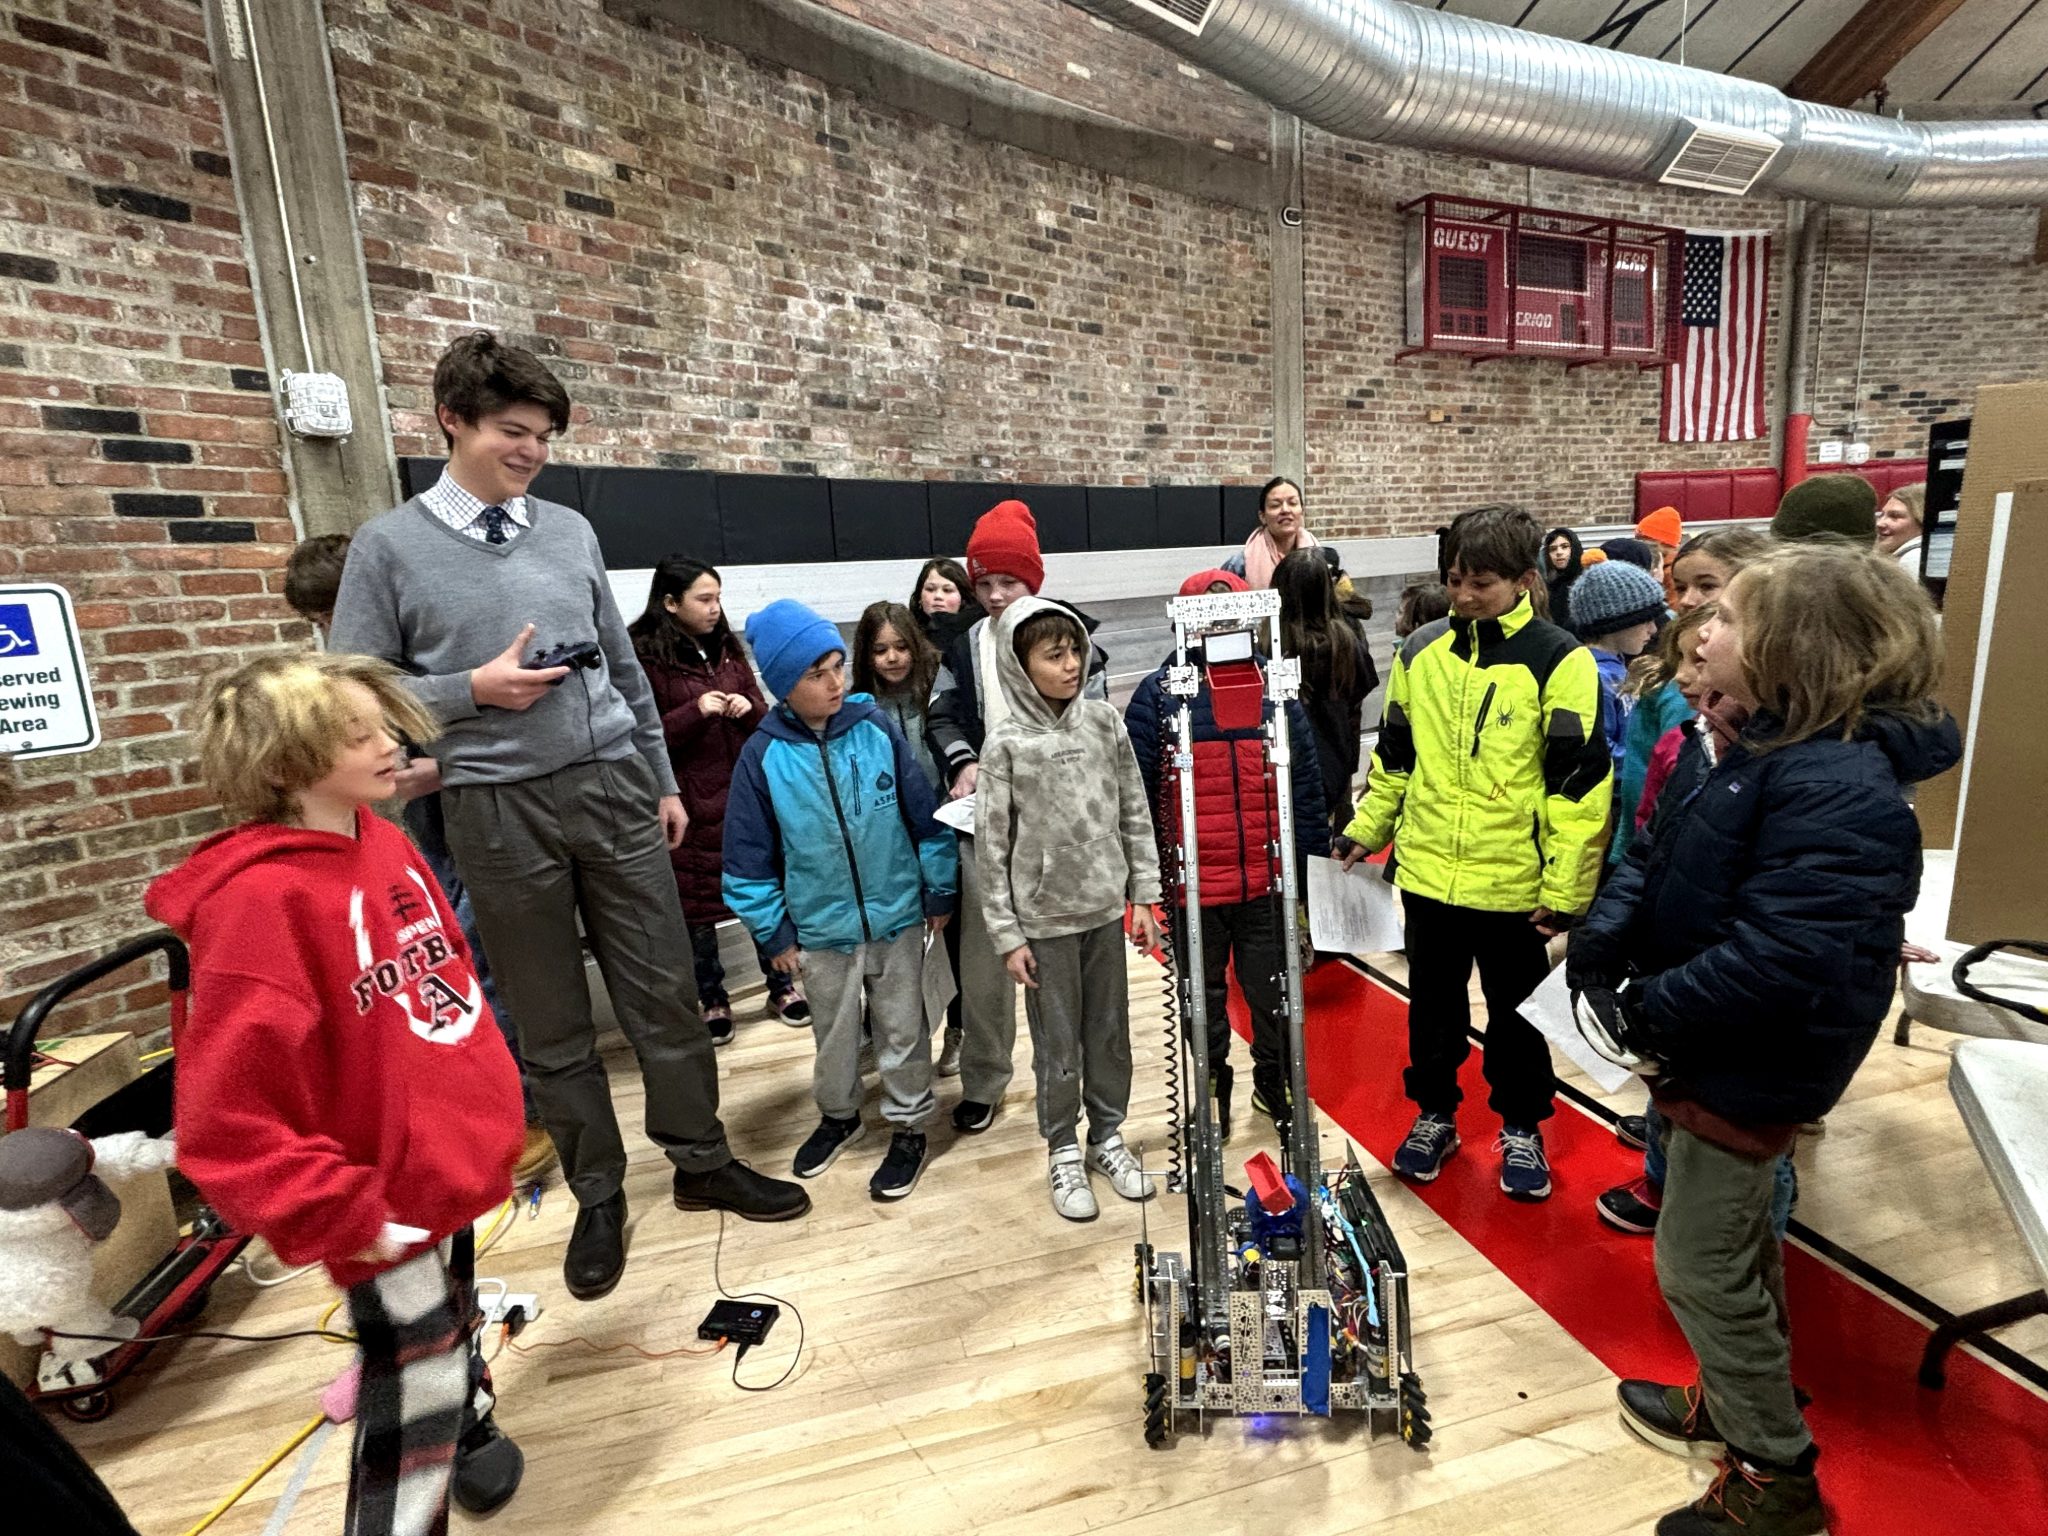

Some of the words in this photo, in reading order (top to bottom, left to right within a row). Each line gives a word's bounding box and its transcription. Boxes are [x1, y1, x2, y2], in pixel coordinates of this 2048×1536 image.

[1433, 227, 1492, 253] GUEST
[1506, 311, 1552, 328] ERIOD
[0, 692, 61, 711] ewing
[0, 718, 48, 735] Area
[874, 792, 897, 807] ASPE
[395, 916, 439, 945] SPEN
[351, 931, 456, 1016] FOTB
